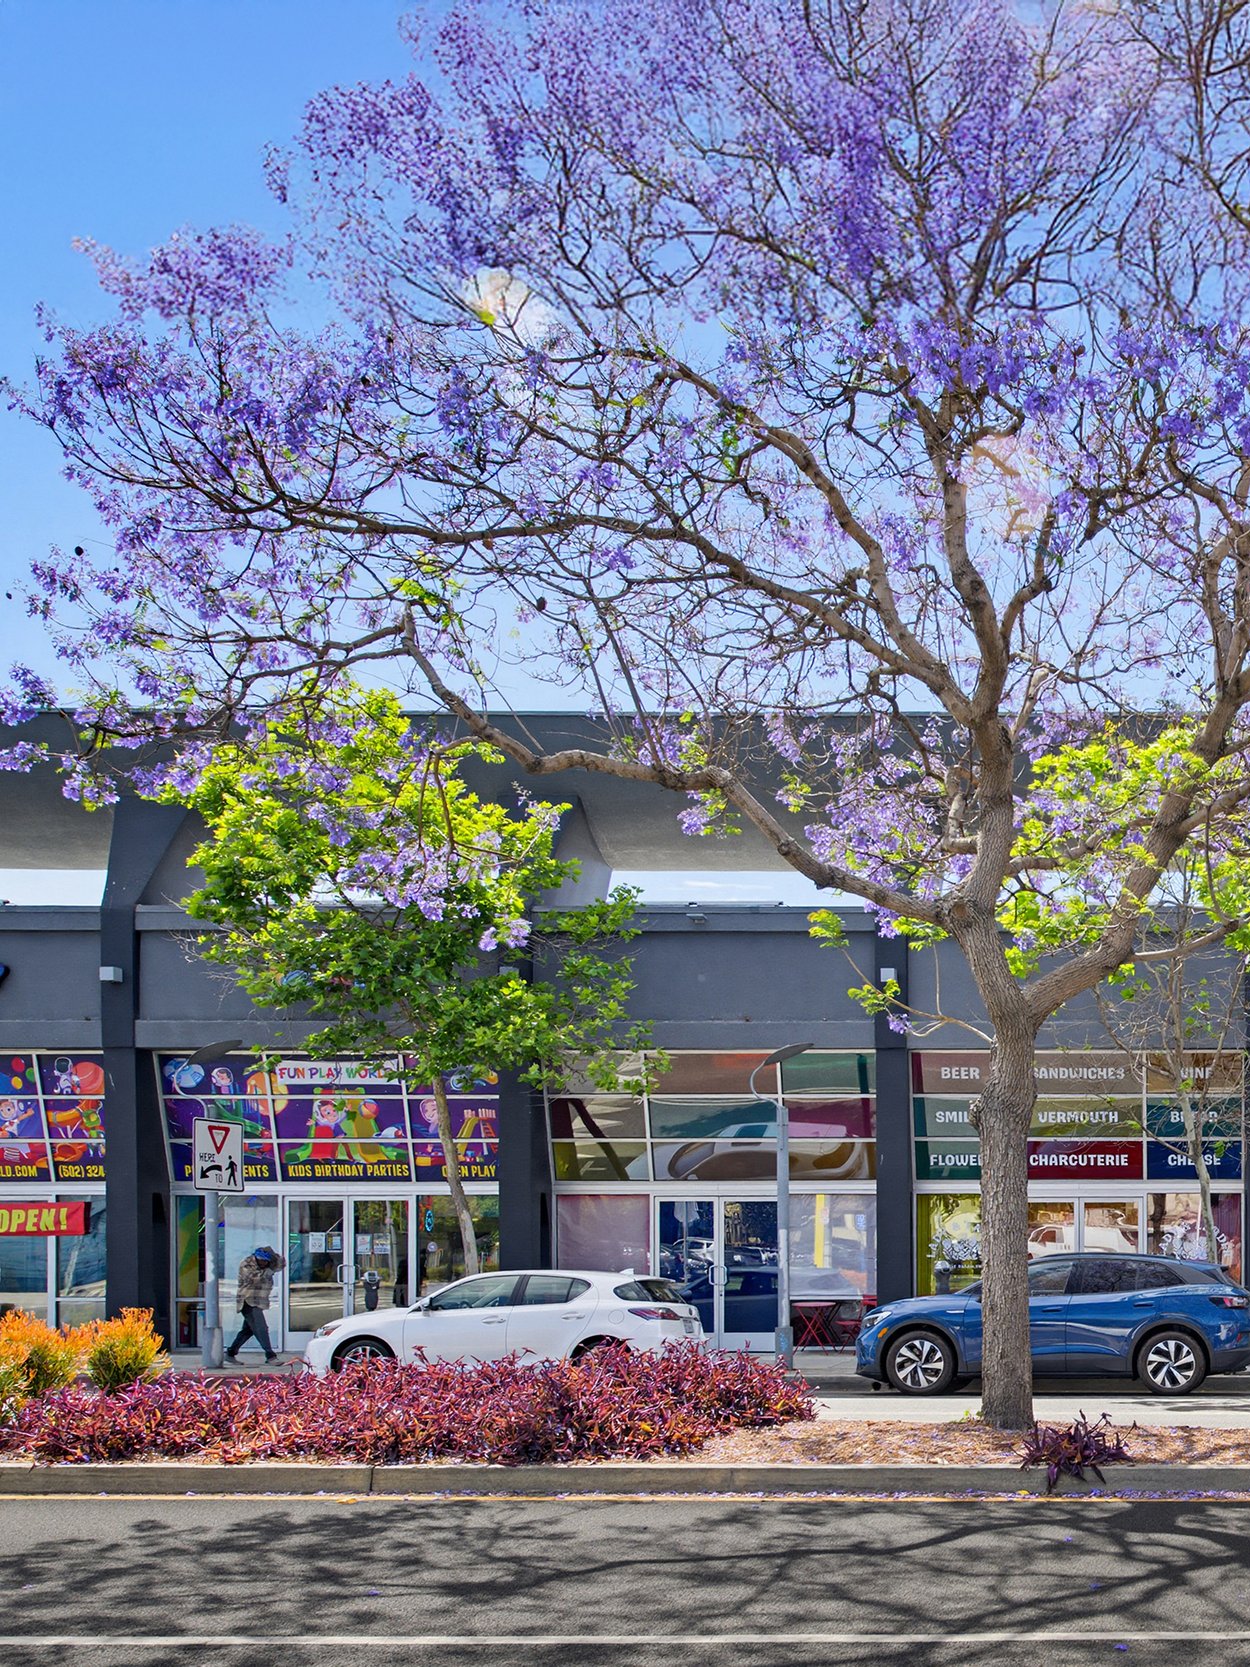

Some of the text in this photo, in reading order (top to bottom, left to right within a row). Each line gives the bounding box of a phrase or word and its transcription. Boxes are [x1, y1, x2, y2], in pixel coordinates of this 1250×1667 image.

[279, 1067, 305, 1079] FUN
[308, 1067, 342, 1079] PLAY
[941, 1067, 980, 1079] BEER
[1038, 1111, 1119, 1123] VERMOUTH
[1029, 1154, 1129, 1167] CHARCUTERIE
[1168, 1154, 1221, 1166] CHESE
[59, 1165, 85, 1178] (502)
[288, 1165, 410, 1177] KIDS BIRTHDAY PARTIES
[471, 1165, 496, 1177] PLAY
